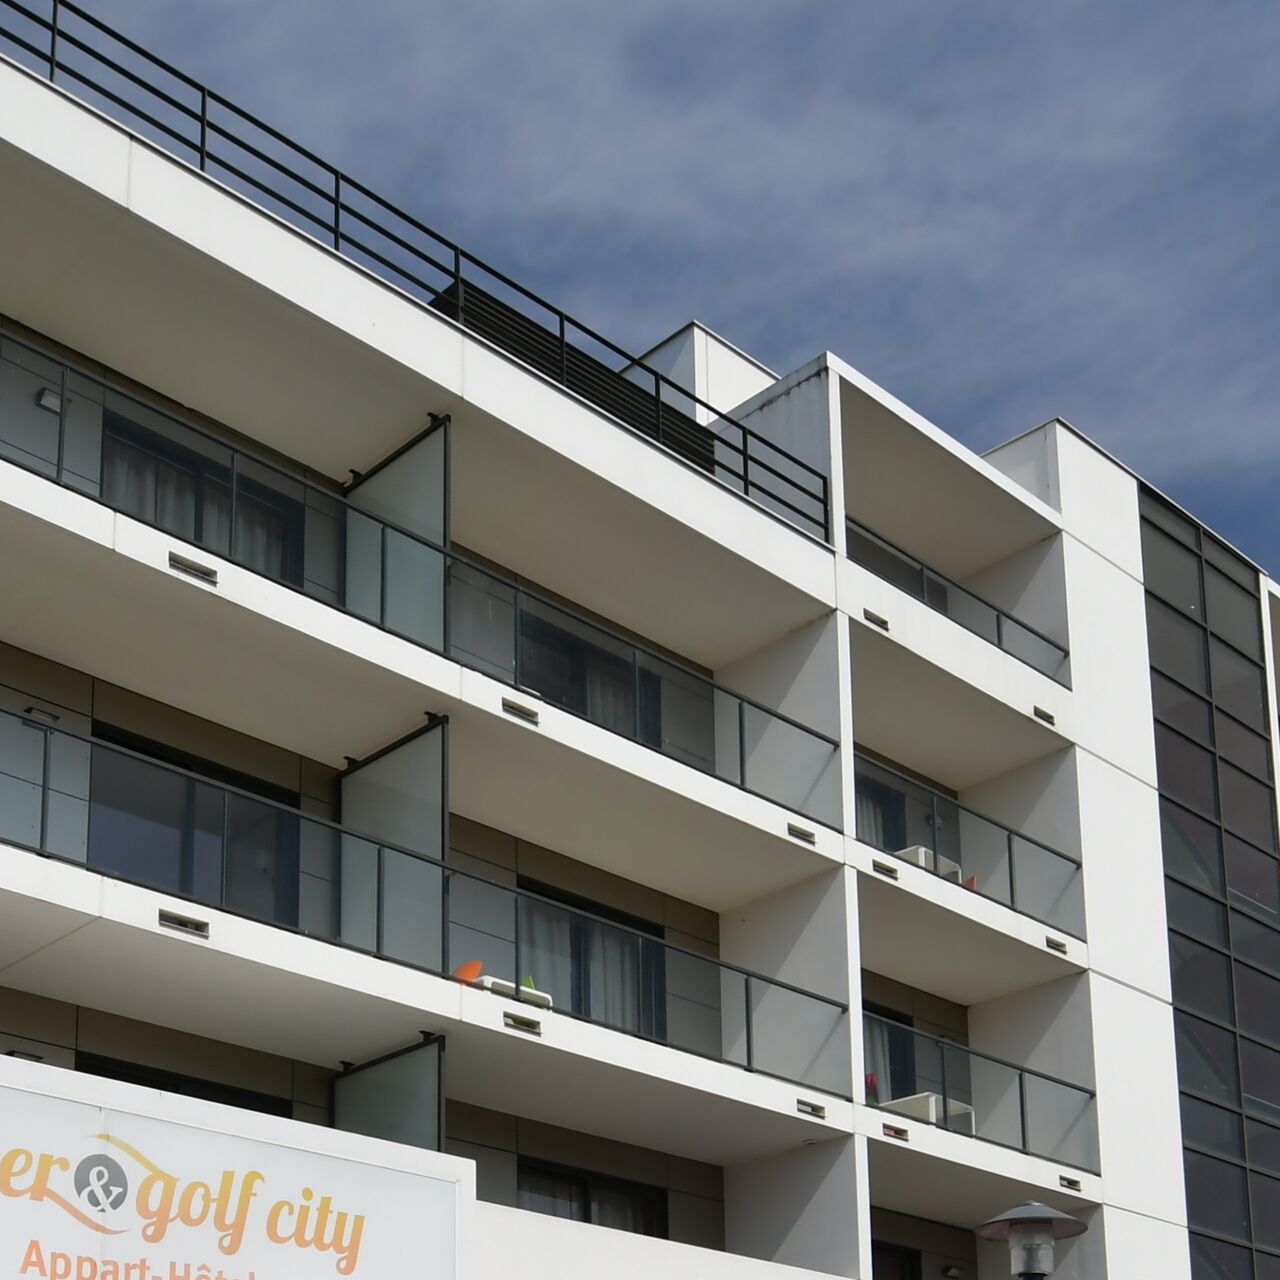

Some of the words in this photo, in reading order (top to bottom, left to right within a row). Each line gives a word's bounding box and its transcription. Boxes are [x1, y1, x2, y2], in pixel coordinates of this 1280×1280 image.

[78, 1164, 124, 1213] &
[105, 1146, 265, 1256] golf
[266, 1187, 366, 1276] city
